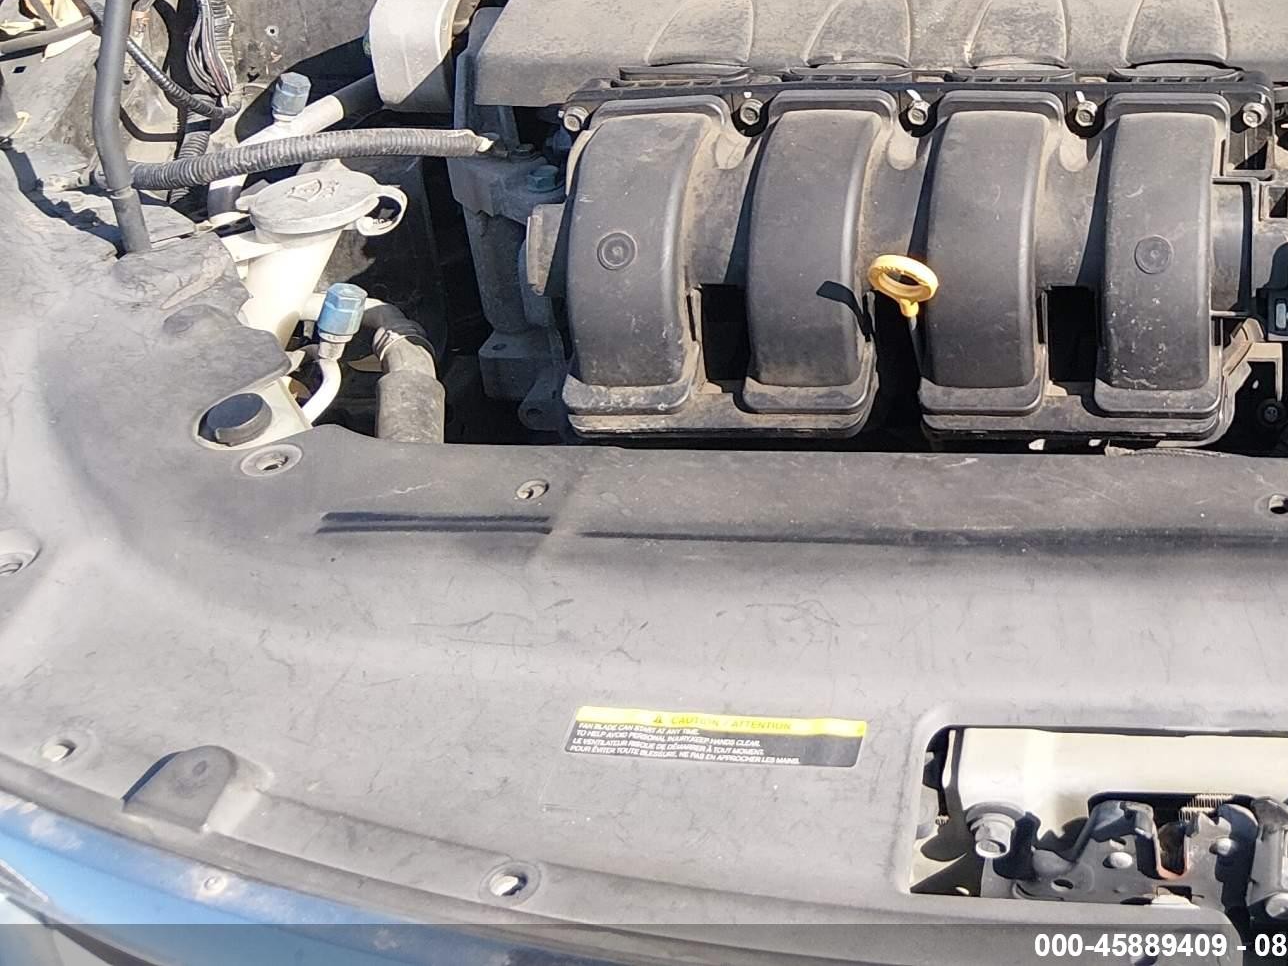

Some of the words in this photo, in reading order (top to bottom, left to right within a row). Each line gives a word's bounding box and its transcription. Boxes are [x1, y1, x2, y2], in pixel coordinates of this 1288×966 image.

[594, 723, 617, 731] BLADE
[617, 724, 634, 732] CAN
[635, 725, 656, 733] START
[671, 716, 720, 727] CAUTION
[730, 721, 792, 730] ATTENTION
[576, 729, 588, 737] TO
[587, 730, 606, 738] HELP
[628, 732, 666, 741] PERSONAL
[572, 737, 584, 745] LE
[584, 738, 628, 747] VENTILATEUR
[655, 742, 666, 750] DE
[712, 746, 733, 754] TOUT
[591, 745, 617, 754] ÉVITER
[617, 747, 640, 755] TOUTE
[678, 751, 690, 759] NE
[690, 752, 705, 760] PAS
[716, 754, 761, 763] APPROCHER
[761, 756, 776, 764] LES
